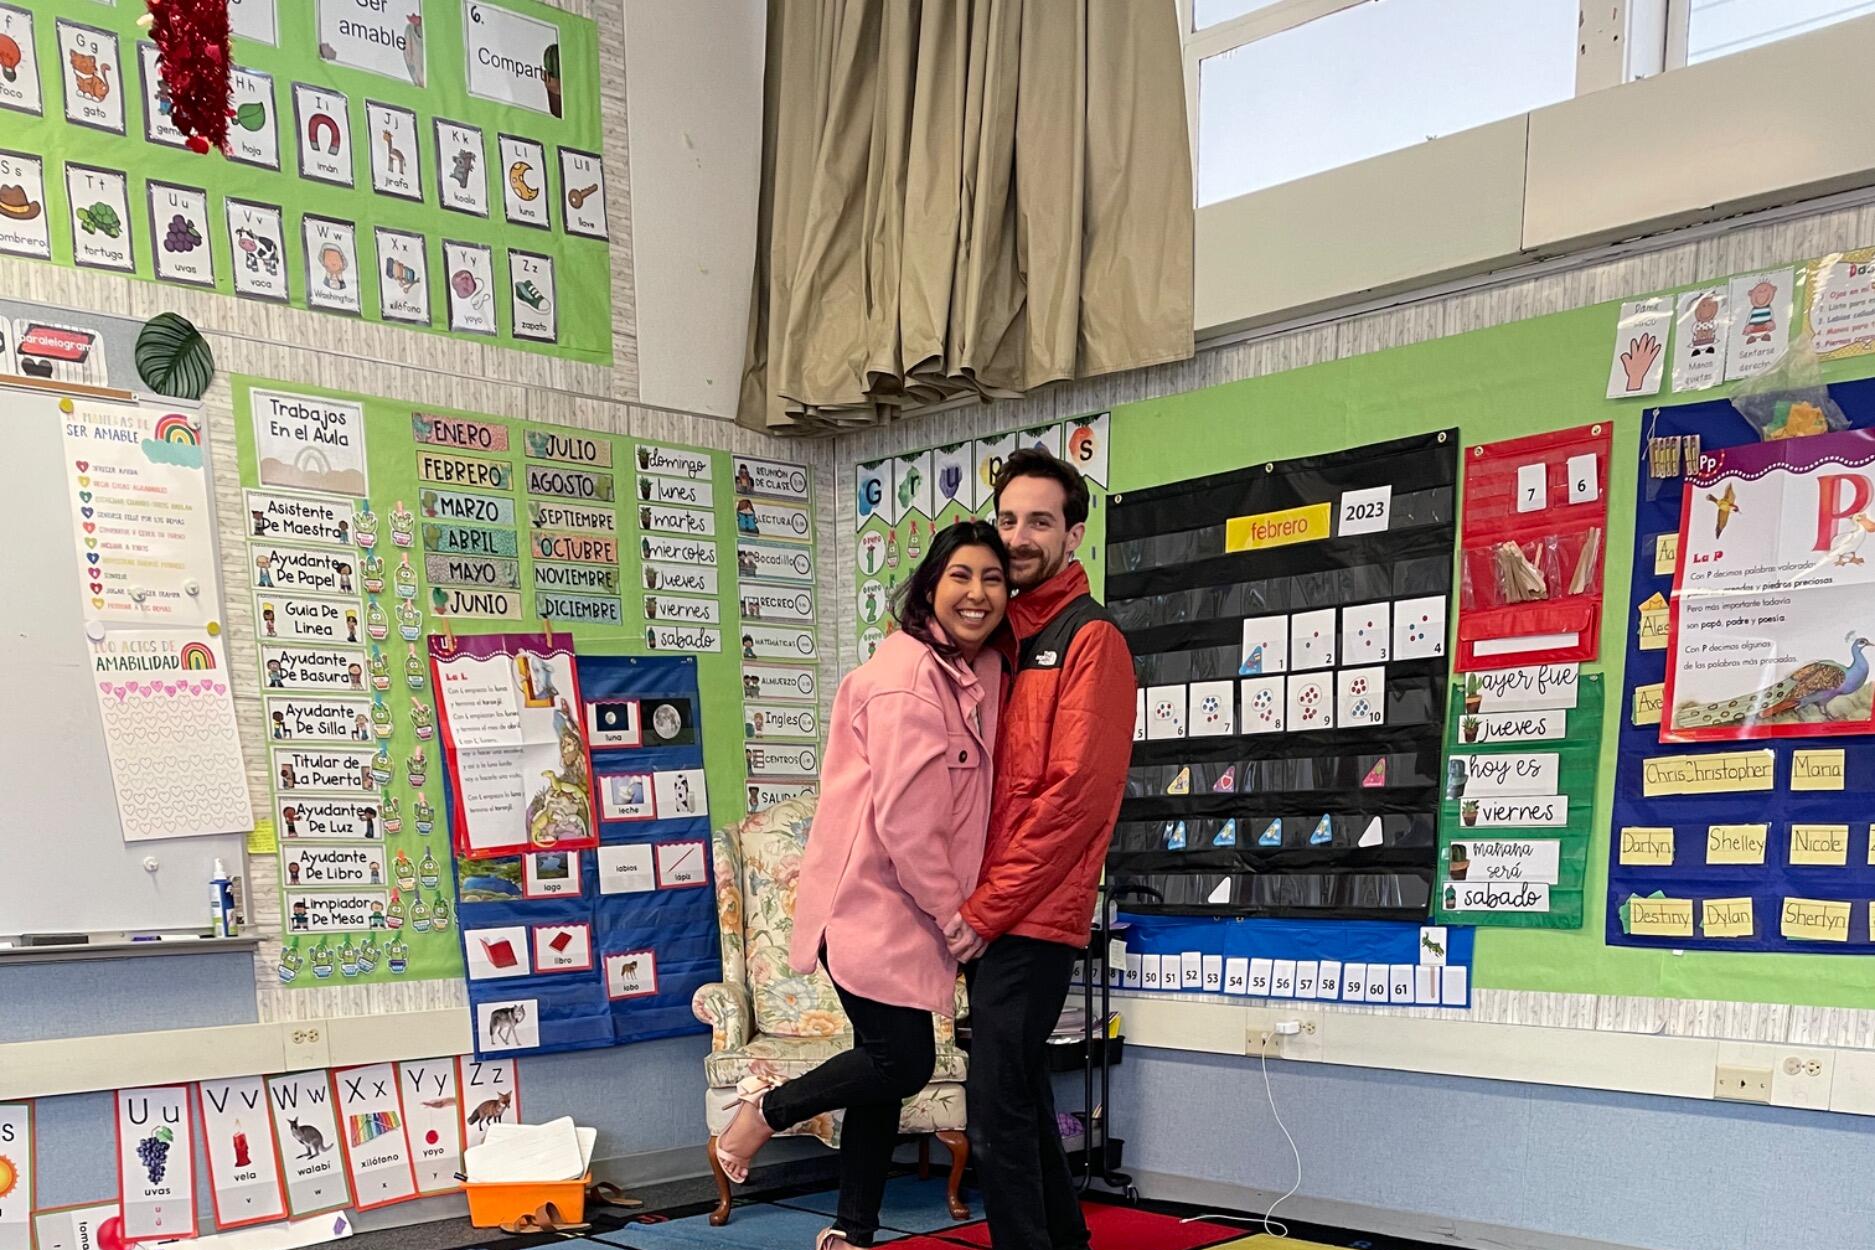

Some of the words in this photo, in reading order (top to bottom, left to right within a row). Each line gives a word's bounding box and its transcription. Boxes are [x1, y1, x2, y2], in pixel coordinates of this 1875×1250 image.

[339, 17, 406, 50] amable
[83, 106, 106, 118] gato
[242, 141, 262, 156] hoja
[384, 176, 409, 190] jirafa
[84, 245, 124, 261] tortuga
[174, 263, 197, 275] uvas
[250, 278, 273, 289] vaca
[521, 320, 547, 334] zapato
[270, 399, 346, 430] Trabajos
[67, 424, 87, 437] SER
[94, 427, 139, 444] AMABLE
[270, 421, 290, 438] En
[295, 425, 307, 441] el
[313, 427, 349, 447] Aula
[434, 420, 492, 448] ENERO
[546, 435, 596, 461] JULIO
[424, 457, 502, 487] FEBRERO
[650, 448, 706, 480] domingo
[1699, 454, 1716, 473] Pp
[531, 472, 594, 497] AGOSTO
[658, 478, 696, 502] lunes
[755, 478, 765, 488] DE
[766, 480, 791, 491] CLASE
[1527, 488, 1536, 501] 7
[1577, 479, 1586, 492] 6
[268, 500, 334, 520] Asistente
[440, 497, 499, 522] MARZO
[540, 508, 615, 531] SEPTIEMBRE
[757, 514, 791, 525] LECTURA
[1812, 472, 1873, 552] P
[262, 517, 280, 532] De
[284, 520, 341, 538] Maestra
[654, 511, 705, 533] martes
[1251, 516, 1308, 541] febrero
[1345, 502, 1385, 521] 2023
[449, 529, 498, 554] ABRIL
[540, 537, 614, 562] OCTUBRE
[270, 550, 338, 571] Ayudante
[754, 551, 795, 566] Bocadillo
[1693, 553, 1709, 564] La
[1713, 551, 1724, 561] P
[277, 568, 294, 584] De
[299, 572, 335, 590] Papel
[450, 562, 496, 583] MAYO
[535, 567, 613, 588] NOVIEMBRE
[657, 571, 705, 591] jueves
[1690, 572, 1705, 581] Con
[1713, 568, 1743, 578] decimos
[1744, 565, 1776, 576] palabras
[1762, 580, 1792, 591] piedras
[1793, 577, 1833, 588] preciosas
[285, 601, 318, 618] Guia
[322, 605, 339, 619] De
[451, 591, 507, 615] JUNIO
[546, 598, 618, 620] DICIEMBRE
[660, 601, 709, 620] viernes
[760, 597, 795, 609] RECREO
[866, 597, 877, 622] 2
[295, 620, 333, 636] Linea
[1725, 617, 1750, 628] padre
[1751, 617, 1756, 625] y
[660, 626, 715, 649] sabado
[96, 655, 180, 672] AMABILIDAD
[280, 651, 347, 668] Ayudante
[1278, 658, 1284, 670] 1
[1325, 653, 1333, 664] 2
[1380, 648, 1387, 659] 3
[1433, 642, 1442, 654] 4
[281, 669, 297, 682] De
[301, 670, 349, 684] Basura
[1482, 672, 1534, 698] ayer
[1537, 664, 1578, 695] fue
[286, 703, 355, 723] Ayudante
[296, 721, 314, 735] De
[317, 722, 346, 736] Silla
[1137, 728, 1144, 738] 5
[1177, 725, 1184, 735] 6
[1224, 722, 1231, 733] 7
[1275, 718, 1281, 729] 8
[1324, 715, 1330, 725] 9
[1368, 711, 1382, 722] 10
[1478, 716, 1548, 743] jueves
[605, 733, 622, 743] luna
[293, 754, 340, 769] Titular
[343, 755, 359, 769] de
[1469, 754, 1511, 784] hoy
[1516, 763, 1542, 777] es
[1794, 755, 1841, 777] Maria
[313, 772, 362, 787] Puerta
[296, 803, 364, 819] Ayudante
[618, 806, 639, 815] leche
[1482, 801, 1555, 821] viernes
[309, 820, 327, 833] De
[329, 821, 354, 833] Luz
[1622, 833, 1671, 858] Darlyn
[1709, 827, 1765, 855] Shelley
[1795, 830, 1844, 852] Nicole
[300, 850, 367, 868] Ayudante
[616, 864, 638, 873] labios
[306, 867, 323, 880] De
[327, 867, 363, 880] Libro
[1487, 862, 1523, 880] será
[544, 883, 561, 893] lago
[1464, 882, 1542, 908] sabado
[303, 898, 370, 914] Limpiador
[1633, 902, 1690, 927] Destiny
[1707, 904, 1750, 926] Dylan
[1785, 902, 1847, 930] Sherlyn
[312, 914, 328, 926] De
[332, 913, 365, 925] Mesa
[554, 957, 572, 965] libro
[623, 983, 639, 992] lobo
[1126, 970, 1138, 980] 49
[1145, 972, 1157, 983] 50
[1165, 971, 1176, 983] 51
[1186, 968, 1198, 981] 52
[1207, 972, 1219, 983] 53
[1229, 975, 1243, 987] 54
[1252, 975, 1266, 988] 55
[1276, 977, 1290, 990] 56
[1300, 978, 1313, 990] 57
[1321, 977, 1336, 990] 58
[1347, 980, 1361, 994] 59
[1369, 983, 1384, 996] 60
[1394, 984, 1408, 996] 61
[361, 1153, 400, 1169] xilófono
[422, 1147, 445, 1158] yoyo
[234, 1171, 256, 1182] vela
[297, 1161, 331, 1177] walabí
[144, 1186, 171, 1197] uvas
